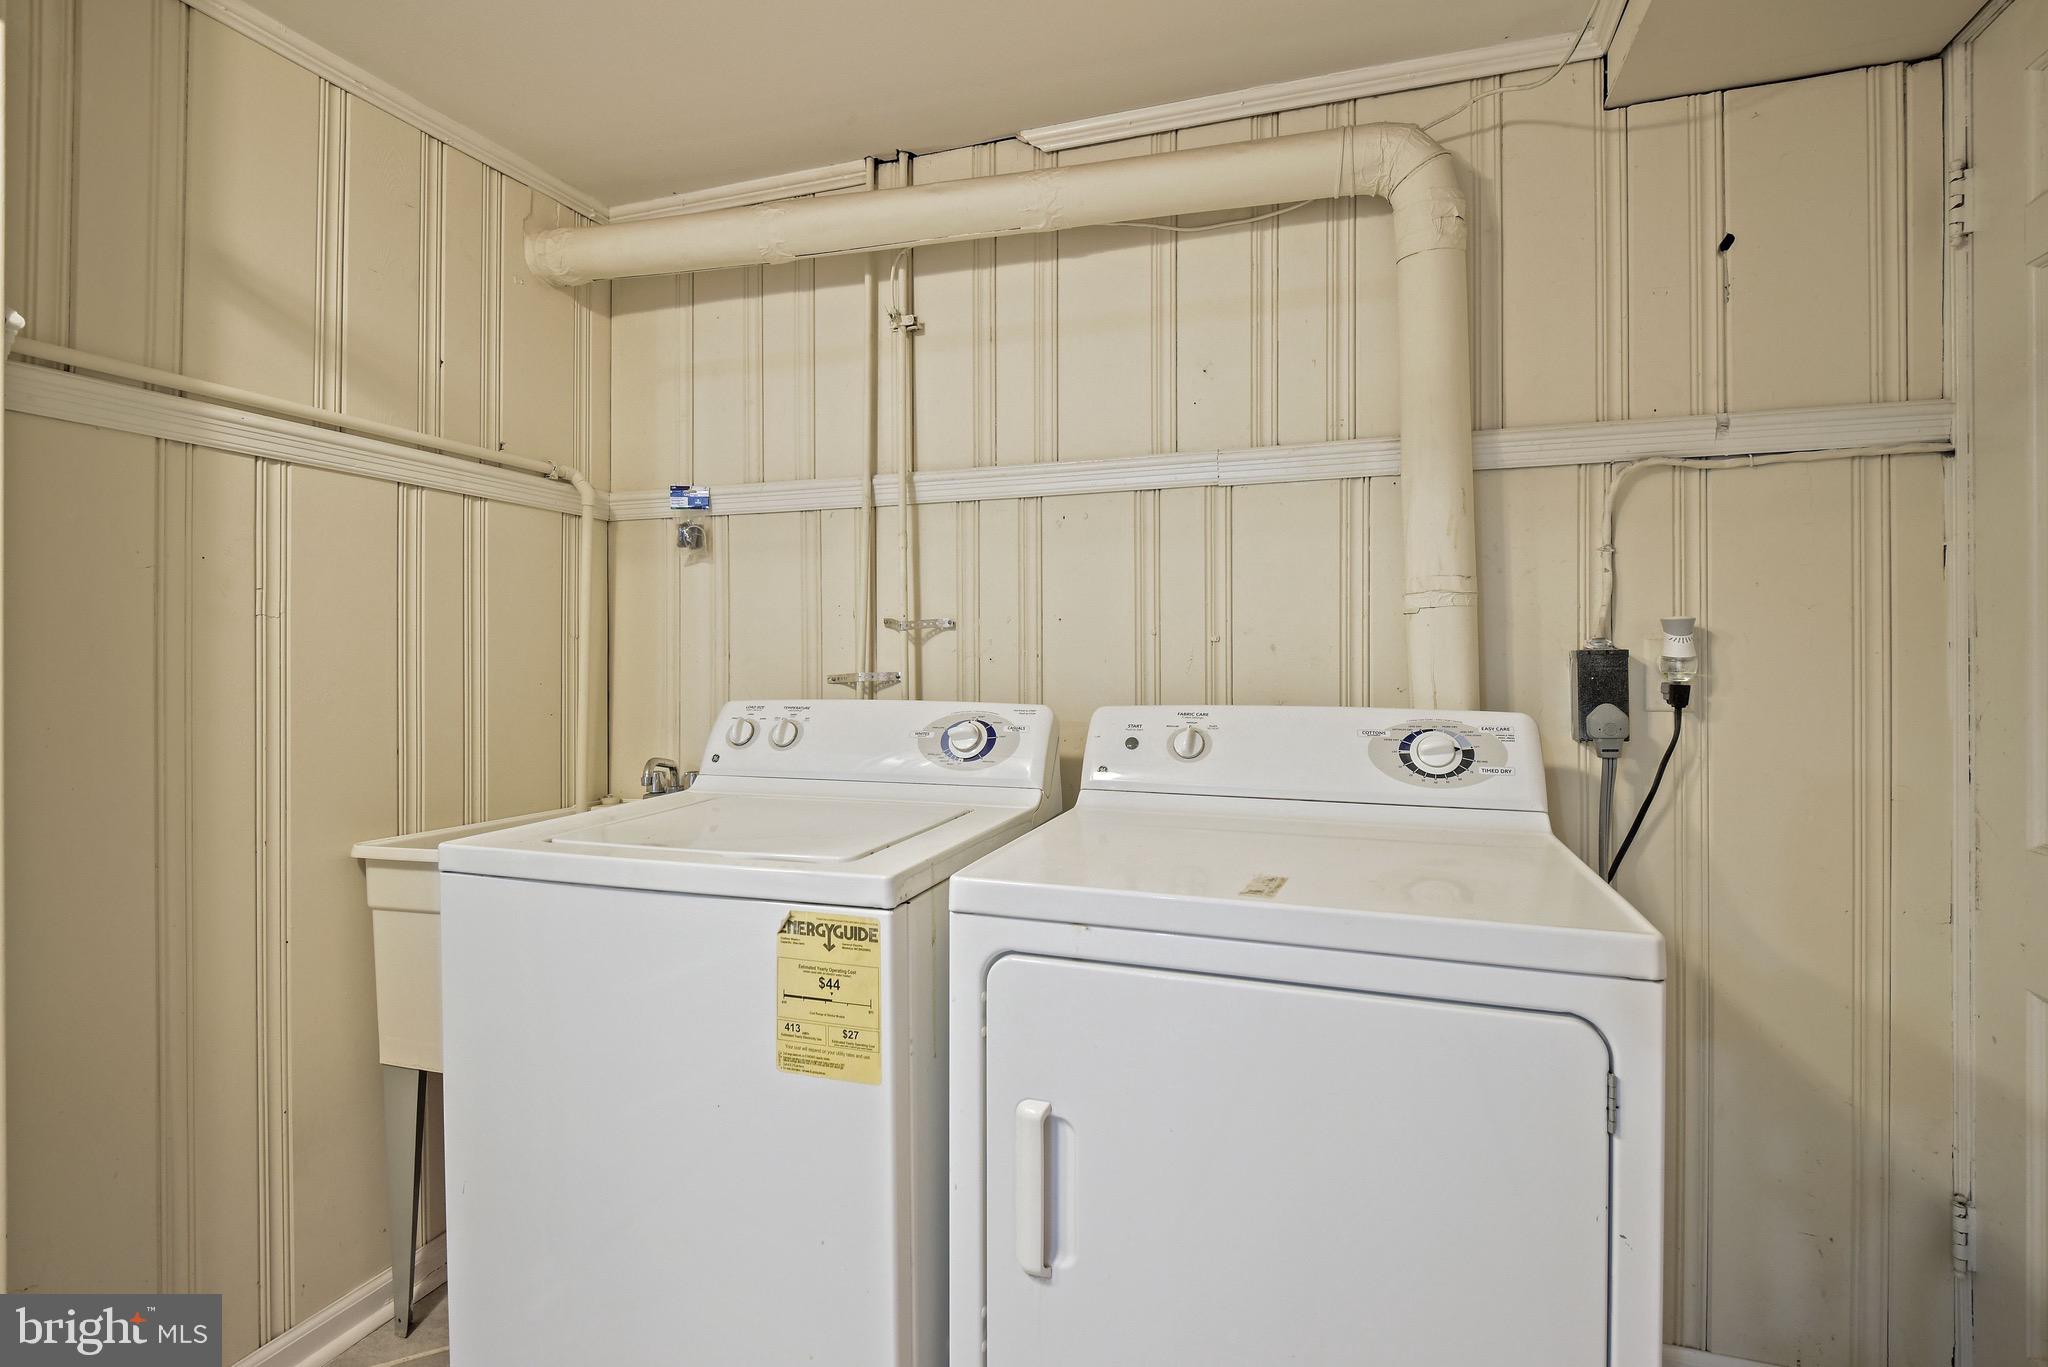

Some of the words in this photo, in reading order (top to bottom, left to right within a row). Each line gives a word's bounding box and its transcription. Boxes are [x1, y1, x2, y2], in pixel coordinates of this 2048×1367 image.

[818, 976, 840, 990] $44
[784, 1022, 800, 1032] 413
[843, 1029, 859, 1040] $27
